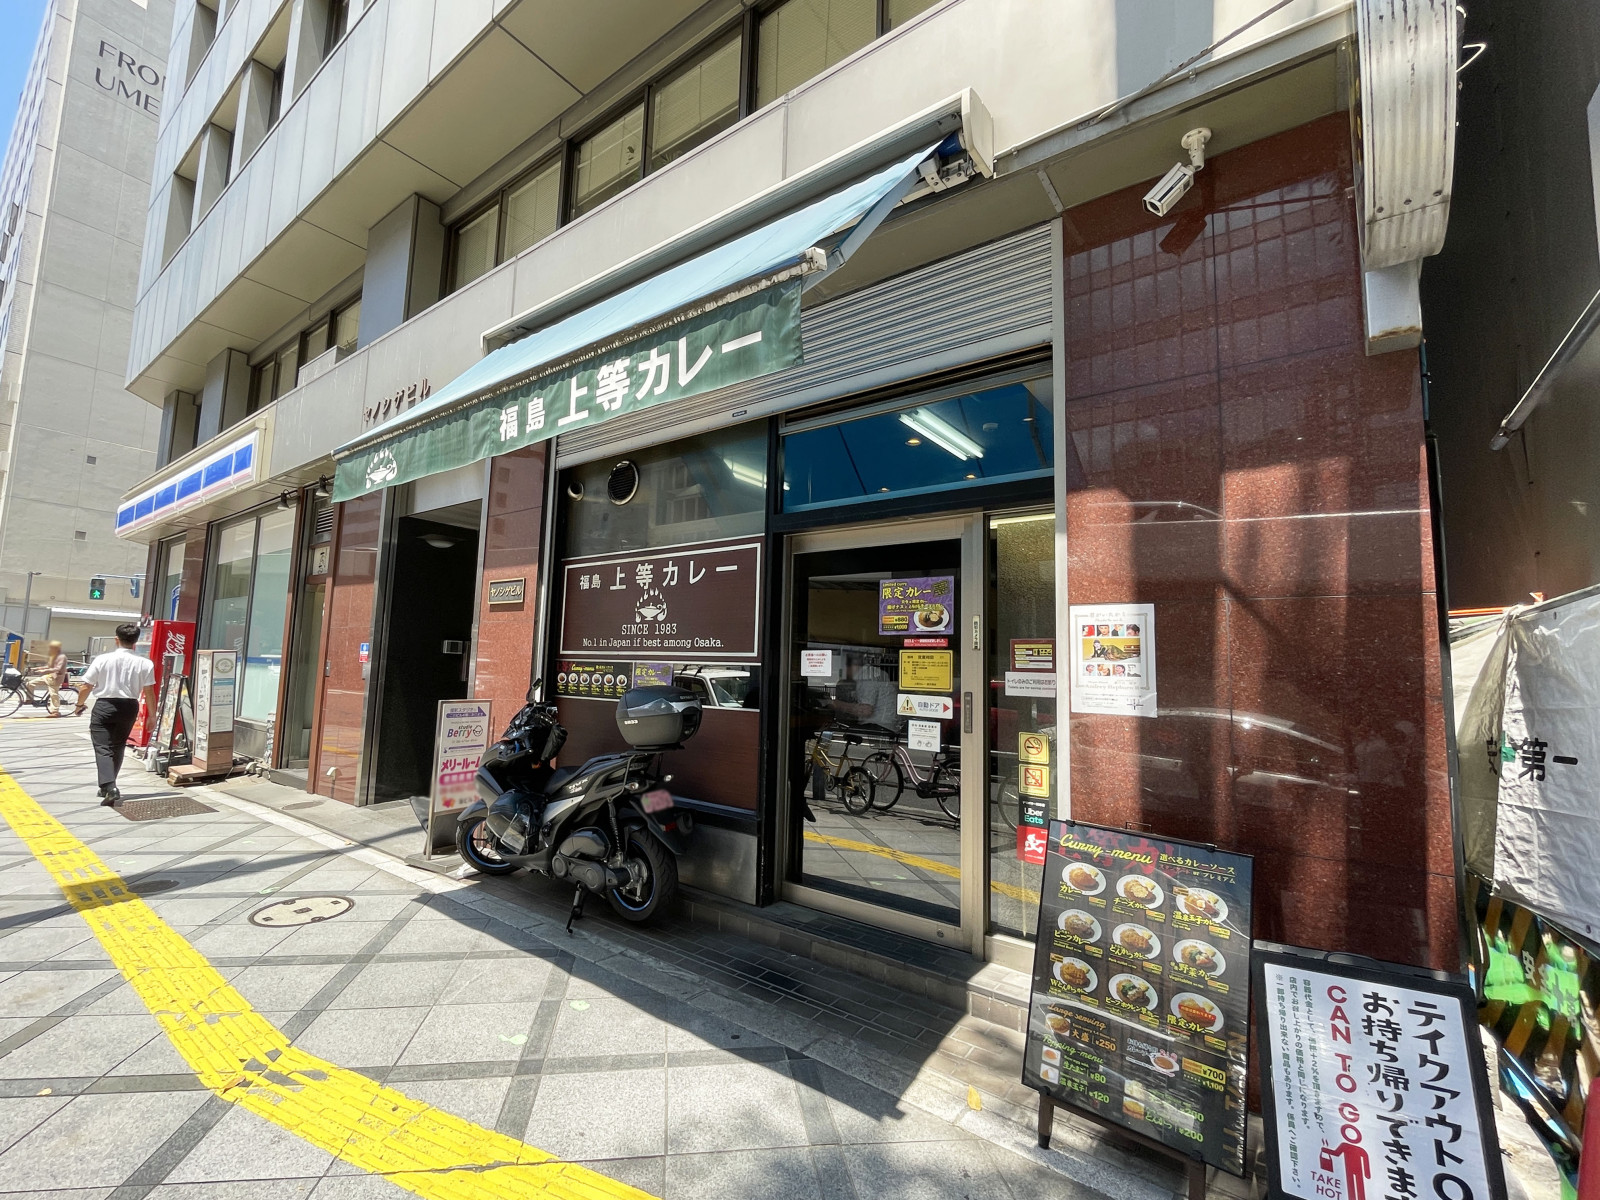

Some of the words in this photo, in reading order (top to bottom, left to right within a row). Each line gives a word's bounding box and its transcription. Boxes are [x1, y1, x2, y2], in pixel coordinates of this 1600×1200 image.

[95, 67, 160, 117] UME
[499, 396, 546, 442] 福島
[556, 330, 763, 426] 上等カレー
[579, 574, 602, 591] 福島
[609, 560, 738, 590] 上等カレー
[490, 585, 523, 597] ヤノシゲビル
[882, 586, 932, 600] 限定カレー
[621, 623, 649, 635] SINCE
[655, 623, 678, 635] 1983
[599, 638, 608, 647] in
[609, 638, 631, 648] Japan
[633, 637, 641, 647] if
[642, 637, 662, 647] best
[663, 640, 692, 649] among
[694, 637, 725, 648] Osaka.
[447, 728, 473, 739] Berry
[1024, 807, 1043, 817] Uber
[1024, 815, 1044, 825] Eats
[1159, 853, 1235, 874] 選べるカレーソース
[1060, 884, 1083, 894] カレー
[1113, 897, 1149, 910] チーズカレー
[1172, 910, 1220, 926] 温泉玉子カレー
[1054, 929, 1091, 944] ビーフカレー
[1109, 944, 1149, 960] とんかつカレー
[1326, 985, 1351, 1044] CAN
[1072, 1028, 1089, 1043] 大盛
[1095, 1038, 1117, 1052] ¥250
[1090, 1072, 1107, 1084] ¥80
[1203, 1068, 1224, 1081] ¥700
[1334, 1052, 1357, 1093] TO
[1202, 1080, 1224, 1092] ¥1,100
[1089, 1090, 1110, 1103] ¥120
[1361, 991, 1419, 1200] お持ち帰りできま
[1338, 1102, 1362, 1144] GO
[1178, 1128, 1204, 1143] ¥200
[1310, 1170, 1341, 1189] TAKE
[1316, 1184, 1342, 1200] HOT
